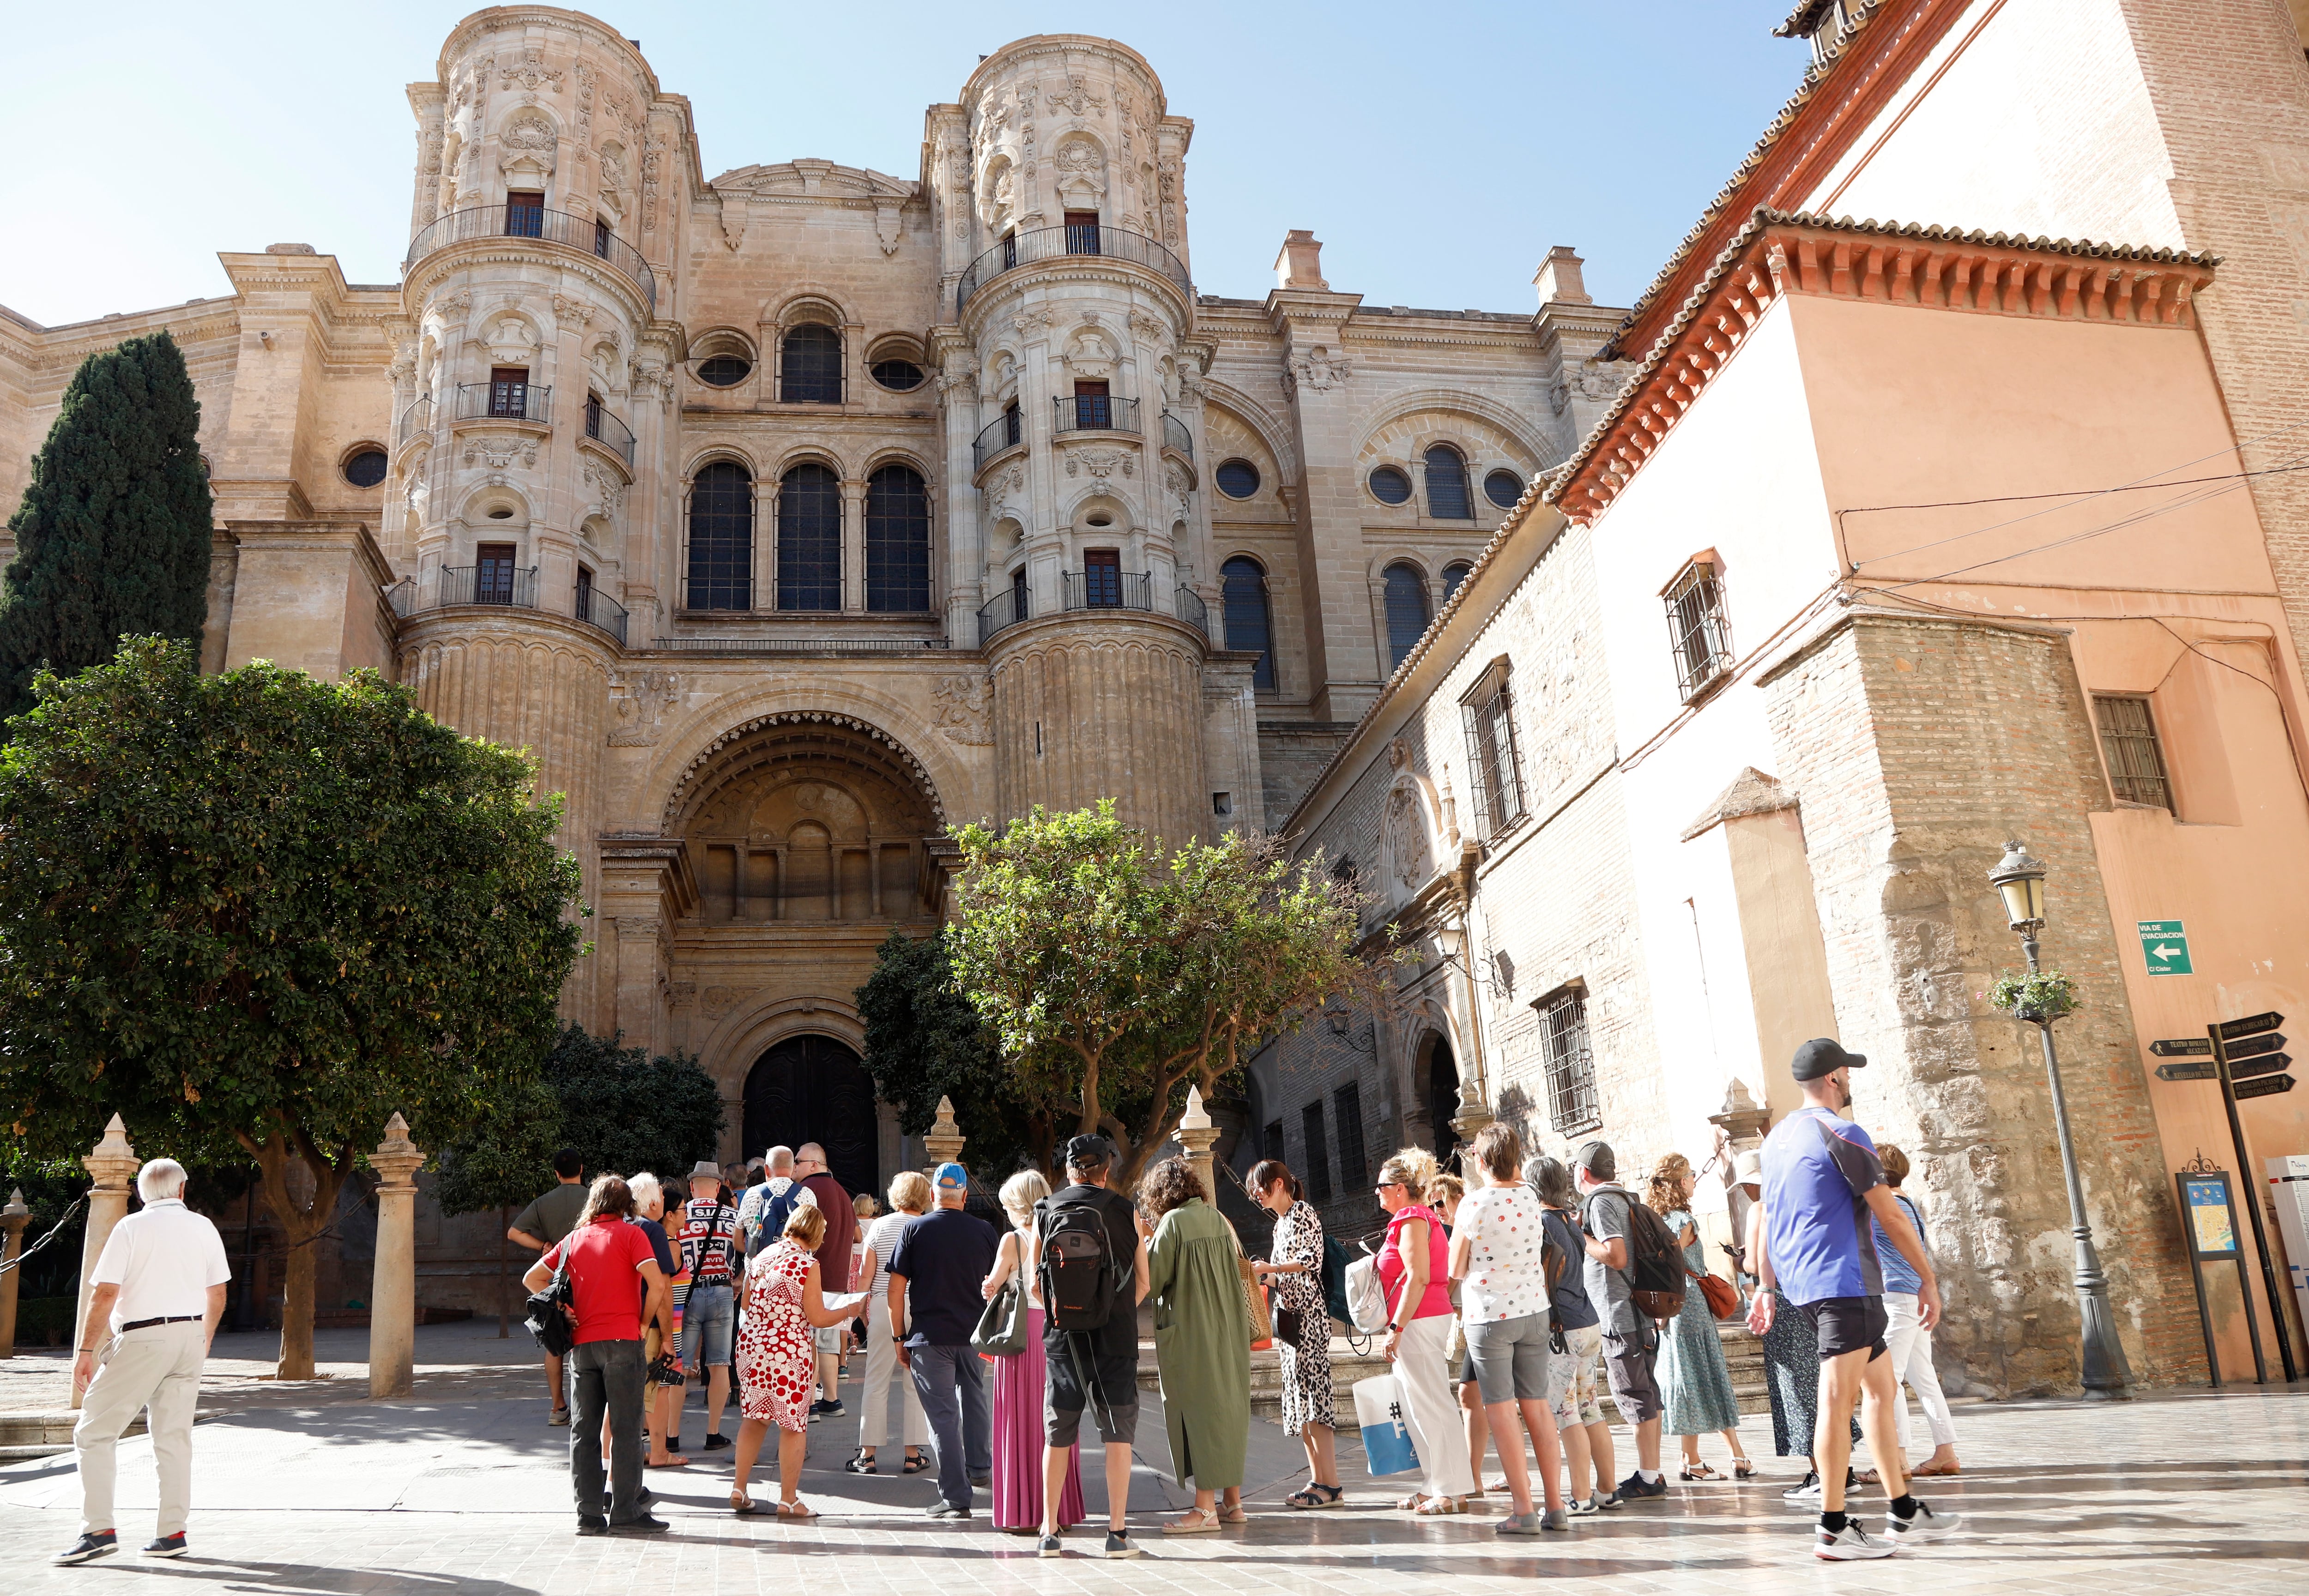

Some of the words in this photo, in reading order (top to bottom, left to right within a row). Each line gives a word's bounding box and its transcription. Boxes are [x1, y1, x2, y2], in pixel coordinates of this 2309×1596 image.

[2223, 1025, 2241, 1035] TEATRO
[2261, 1077, 2280, 1087] PICASSO
[2236, 1090, 2254, 1098] MUSEO
[2266, 1085, 2280, 1093] NATAL
